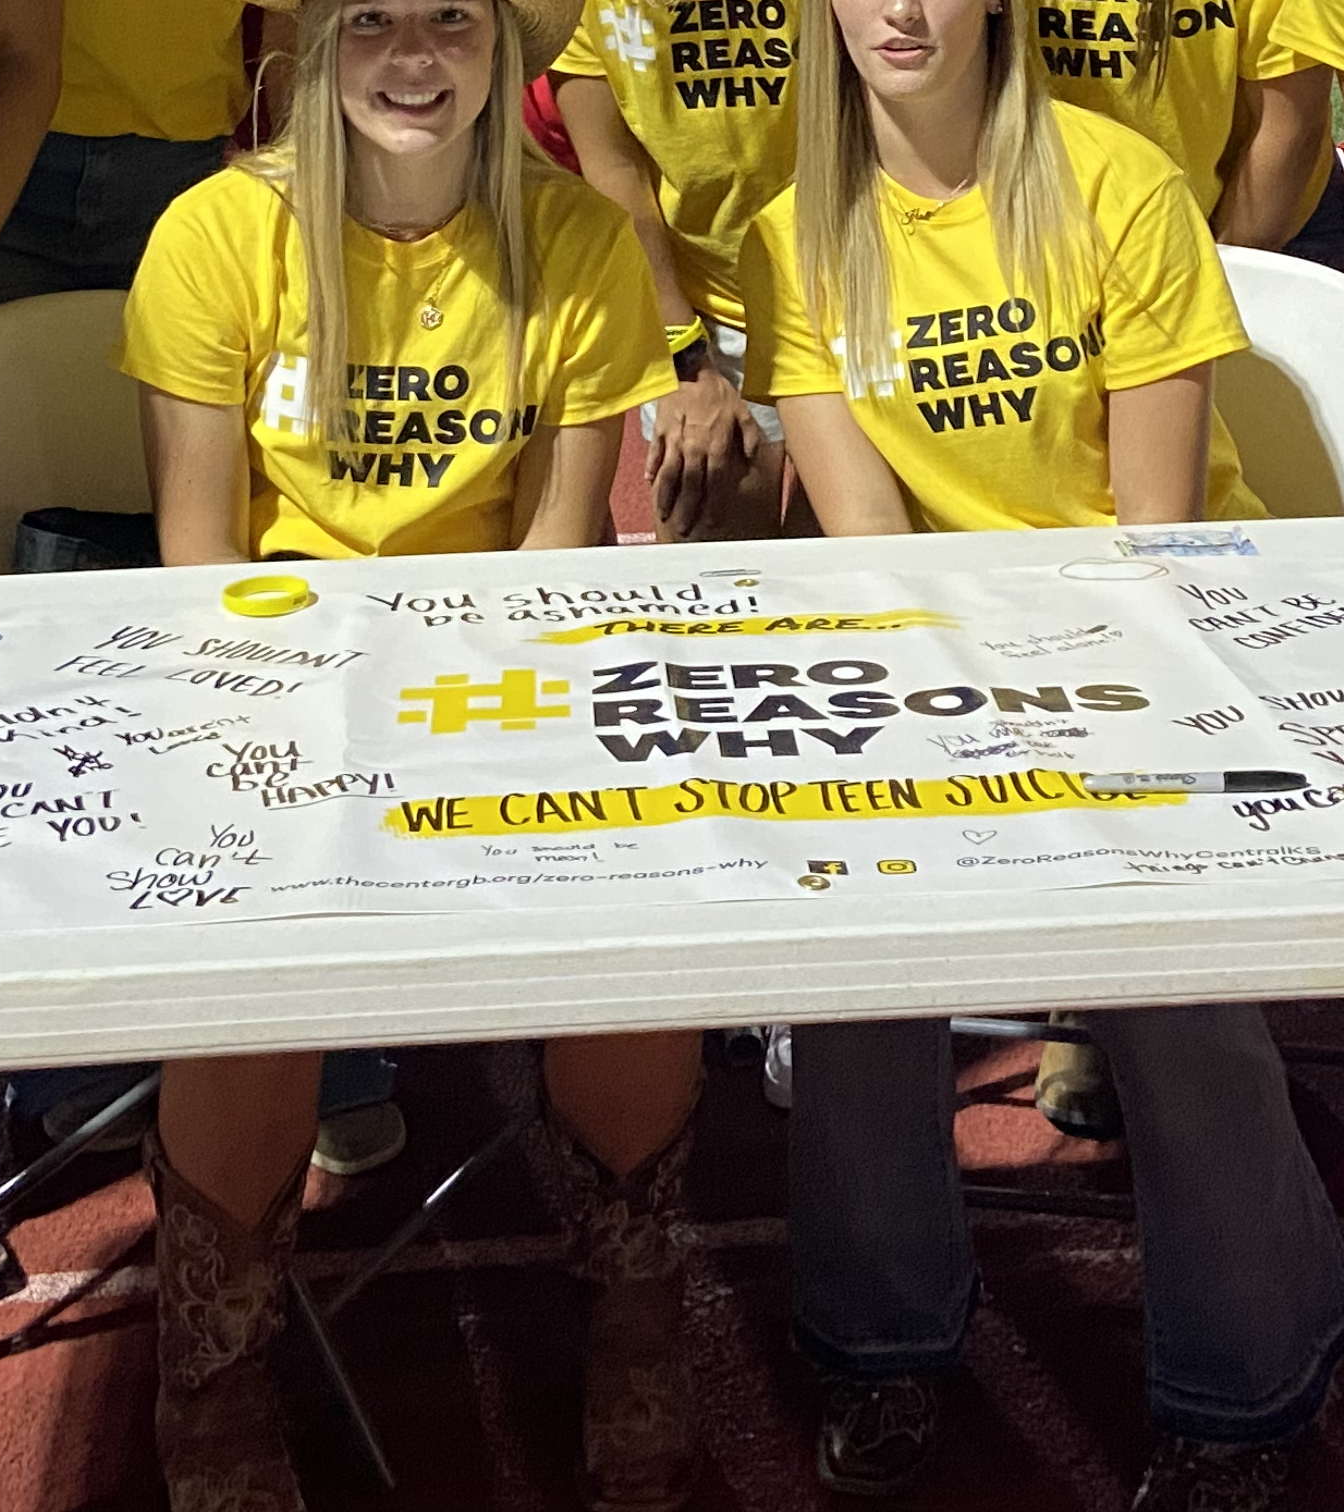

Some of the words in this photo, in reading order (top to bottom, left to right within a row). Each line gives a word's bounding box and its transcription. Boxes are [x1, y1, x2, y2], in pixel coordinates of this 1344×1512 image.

[675, 76, 787, 110] WHY
[906, 296, 1036, 349] ZERO
[916, 385, 1038, 433] WHY
[366, 591, 476, 612] You
[502, 582, 702, 609] should
[424, 611, 485, 627] be
[508, 595, 760, 621] ashamed!
[1280, 591, 1337, 610] BE
[595, 620, 745, 636] THERE
[53, 654, 147, 678] FEEL
[164, 667, 305, 699] LOVED!
[592, 659, 890, 695] ZERO
[593, 683, 1151, 727] REASONS
[1171, 705, 1246, 736] YOU
[595, 724, 887, 762] WHY
[261, 772, 399, 807] HAPPY!
[401, 796, 474, 832] WE
[499, 785, 649, 826] CAN'T
[673, 777, 798, 815] STOP
[808, 775, 921, 812] TEEN
[945, 768, 1148, 807] SUICI
